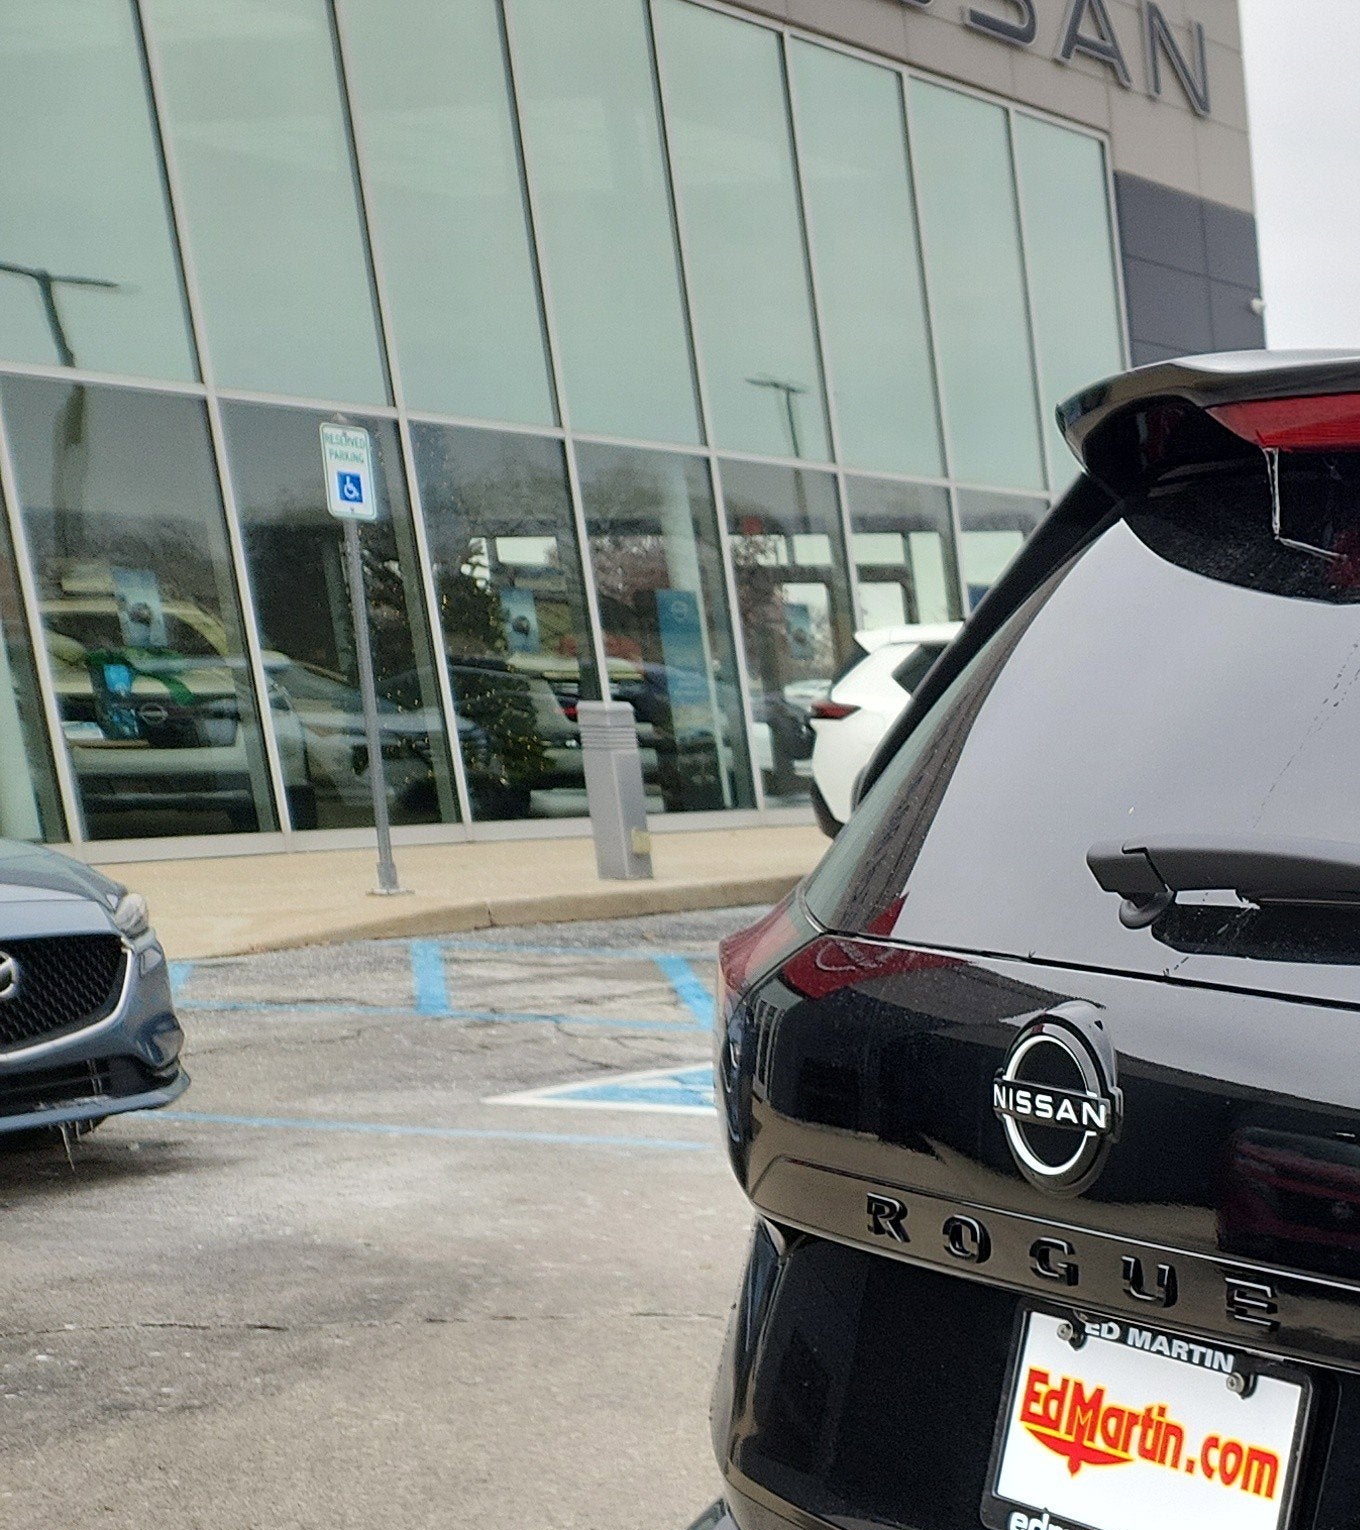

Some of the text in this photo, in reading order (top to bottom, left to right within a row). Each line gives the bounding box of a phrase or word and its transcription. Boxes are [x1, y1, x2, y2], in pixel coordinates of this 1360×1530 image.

[329, 450, 365, 463] PARKING
[993, 1083, 1107, 1129] NISSAN
[866, 1192, 1281, 1333] ROGUE
[1084, 1321, 1236, 1374] ED MARTIN
[1019, 1367, 1280, 1500] EdMartin.com
